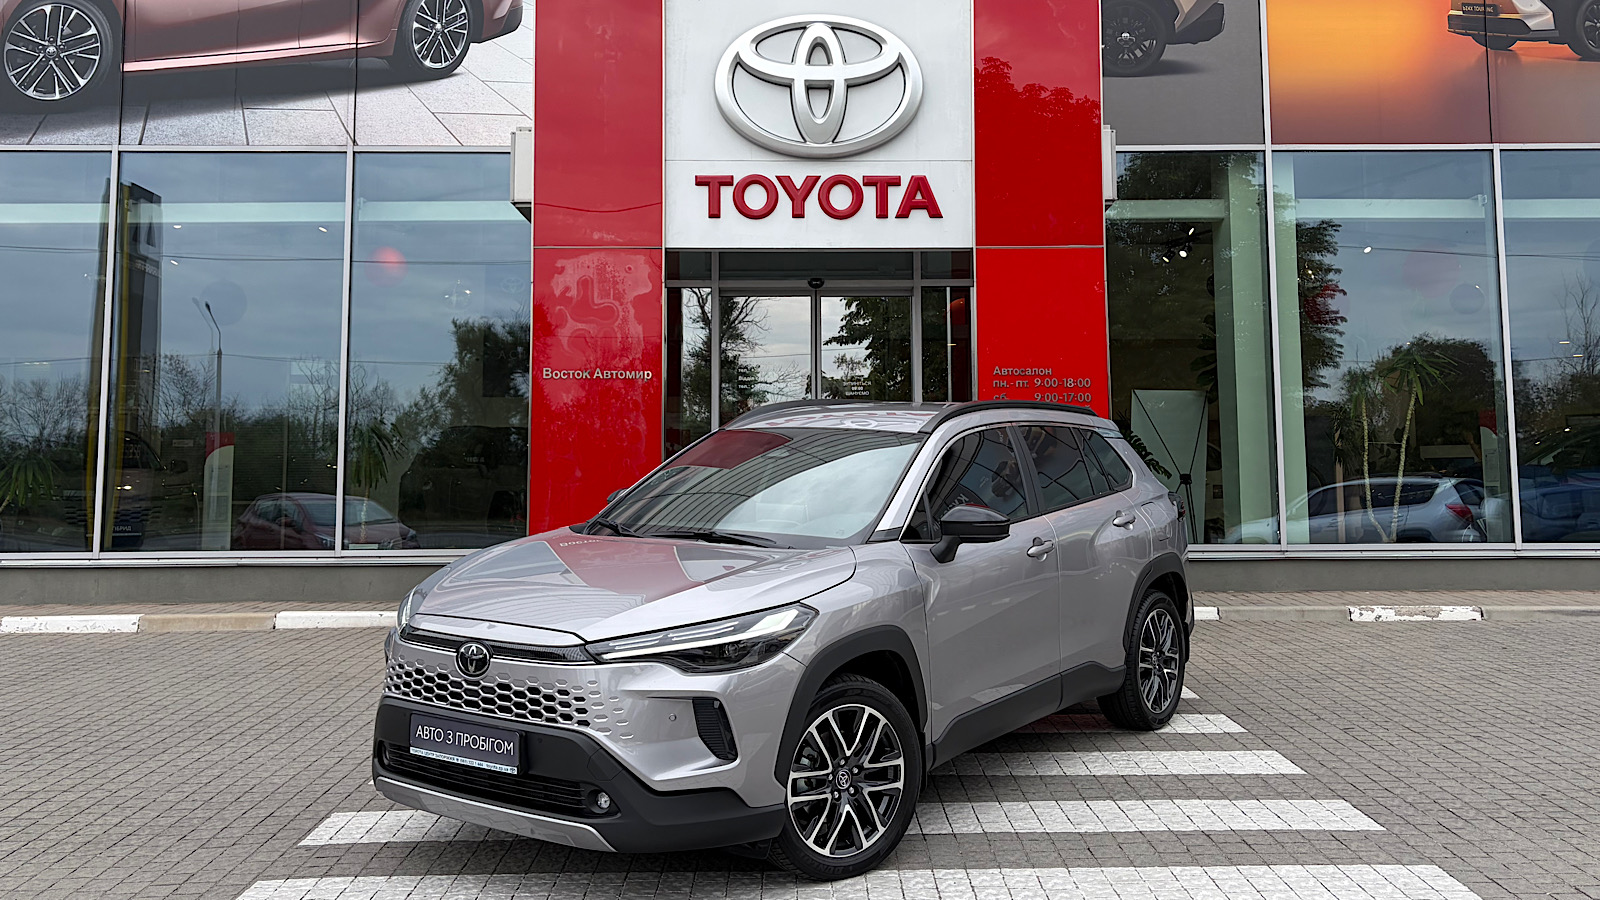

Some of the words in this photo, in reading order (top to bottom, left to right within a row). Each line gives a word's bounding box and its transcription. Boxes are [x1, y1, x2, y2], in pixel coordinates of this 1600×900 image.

[695, 174, 944, 220] TOYOTA
[542, 368, 591, 379] Восток
[593, 368, 653, 382] Автомир
[993, 366, 1052, 376] Автосалон
[1034, 378, 1091, 388] 9:00-18:00
[1034, 393, 1092, 402] 9:00-17:00
[416, 725, 444, 742] АВТО
[446, 730, 453, 744] З
[455, 732, 514, 756] ПРОБІГОМ
